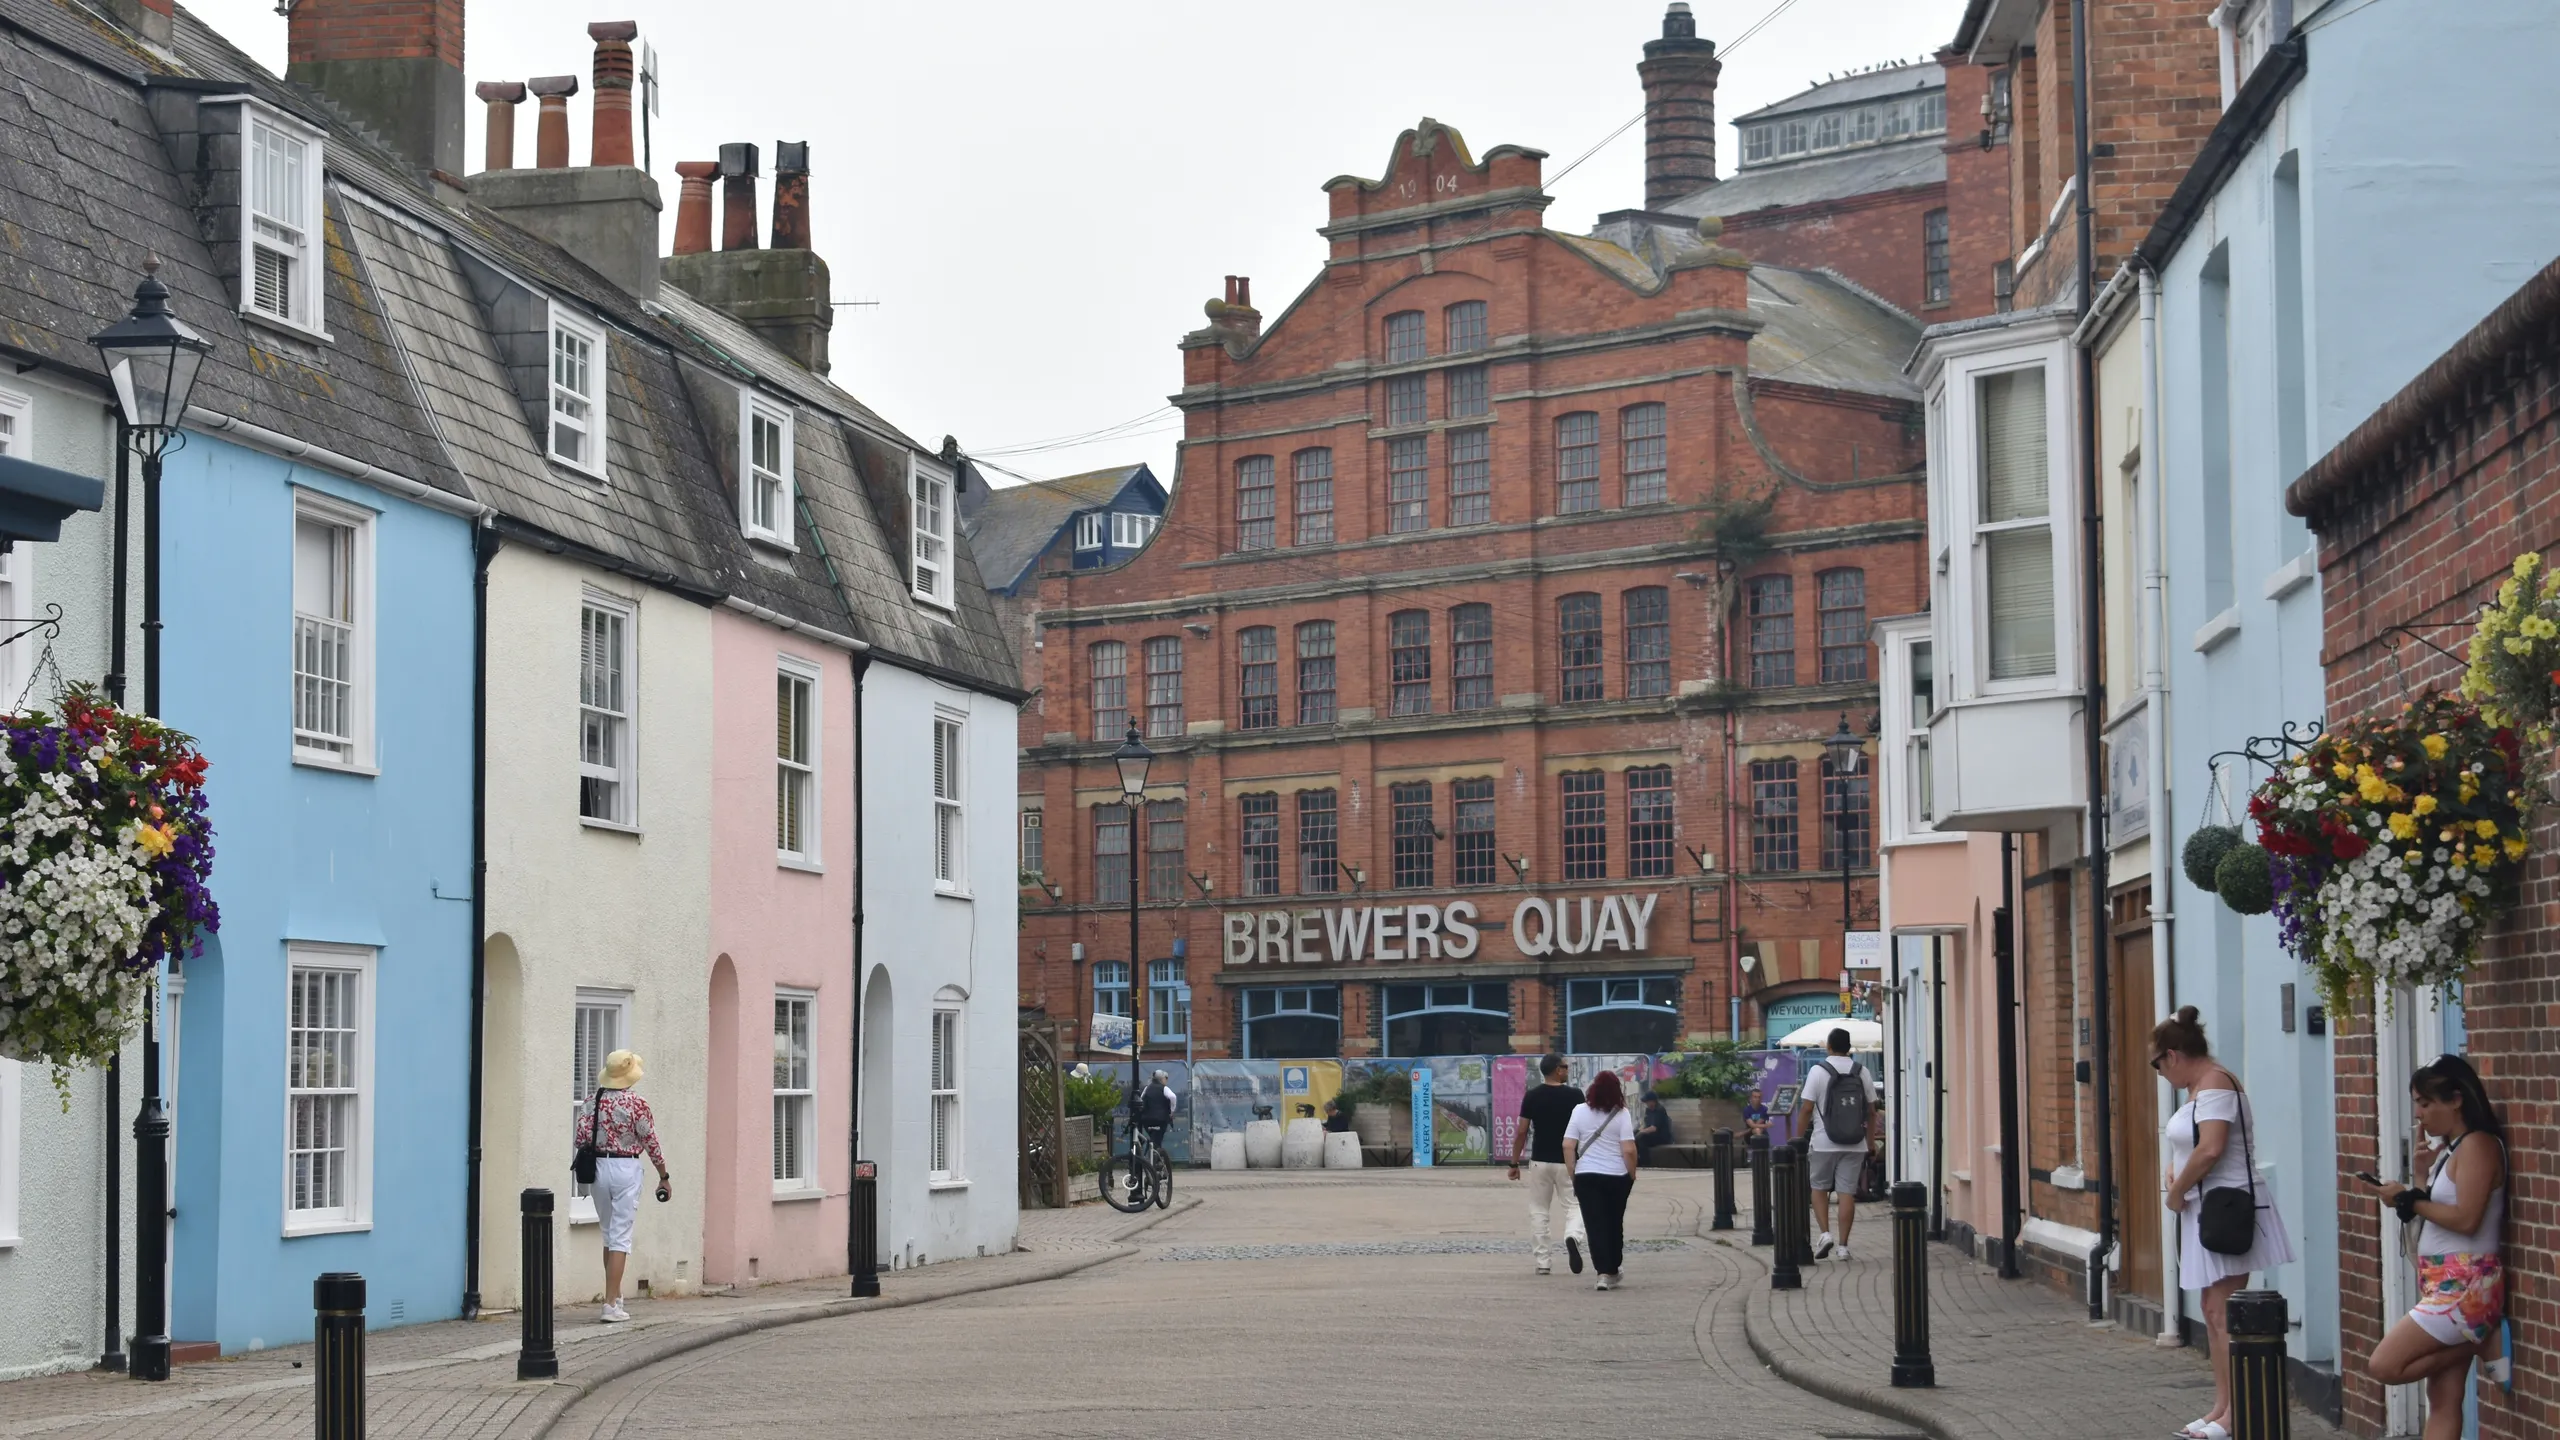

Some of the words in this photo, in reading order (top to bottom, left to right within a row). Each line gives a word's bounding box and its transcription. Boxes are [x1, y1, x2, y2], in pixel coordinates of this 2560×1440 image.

[1436, 174, 1457, 193] 04
[1223, 901, 1480, 964] BREWERS
[1512, 893, 1659, 957] QUAY
[1770, 1004, 1827, 1016] WEYMOUTH
[1423, 1109, 1430, 1121] 30
[1495, 1115, 1504, 1157] SHOP
[1505, 1115, 1514, 1157] SHOP
